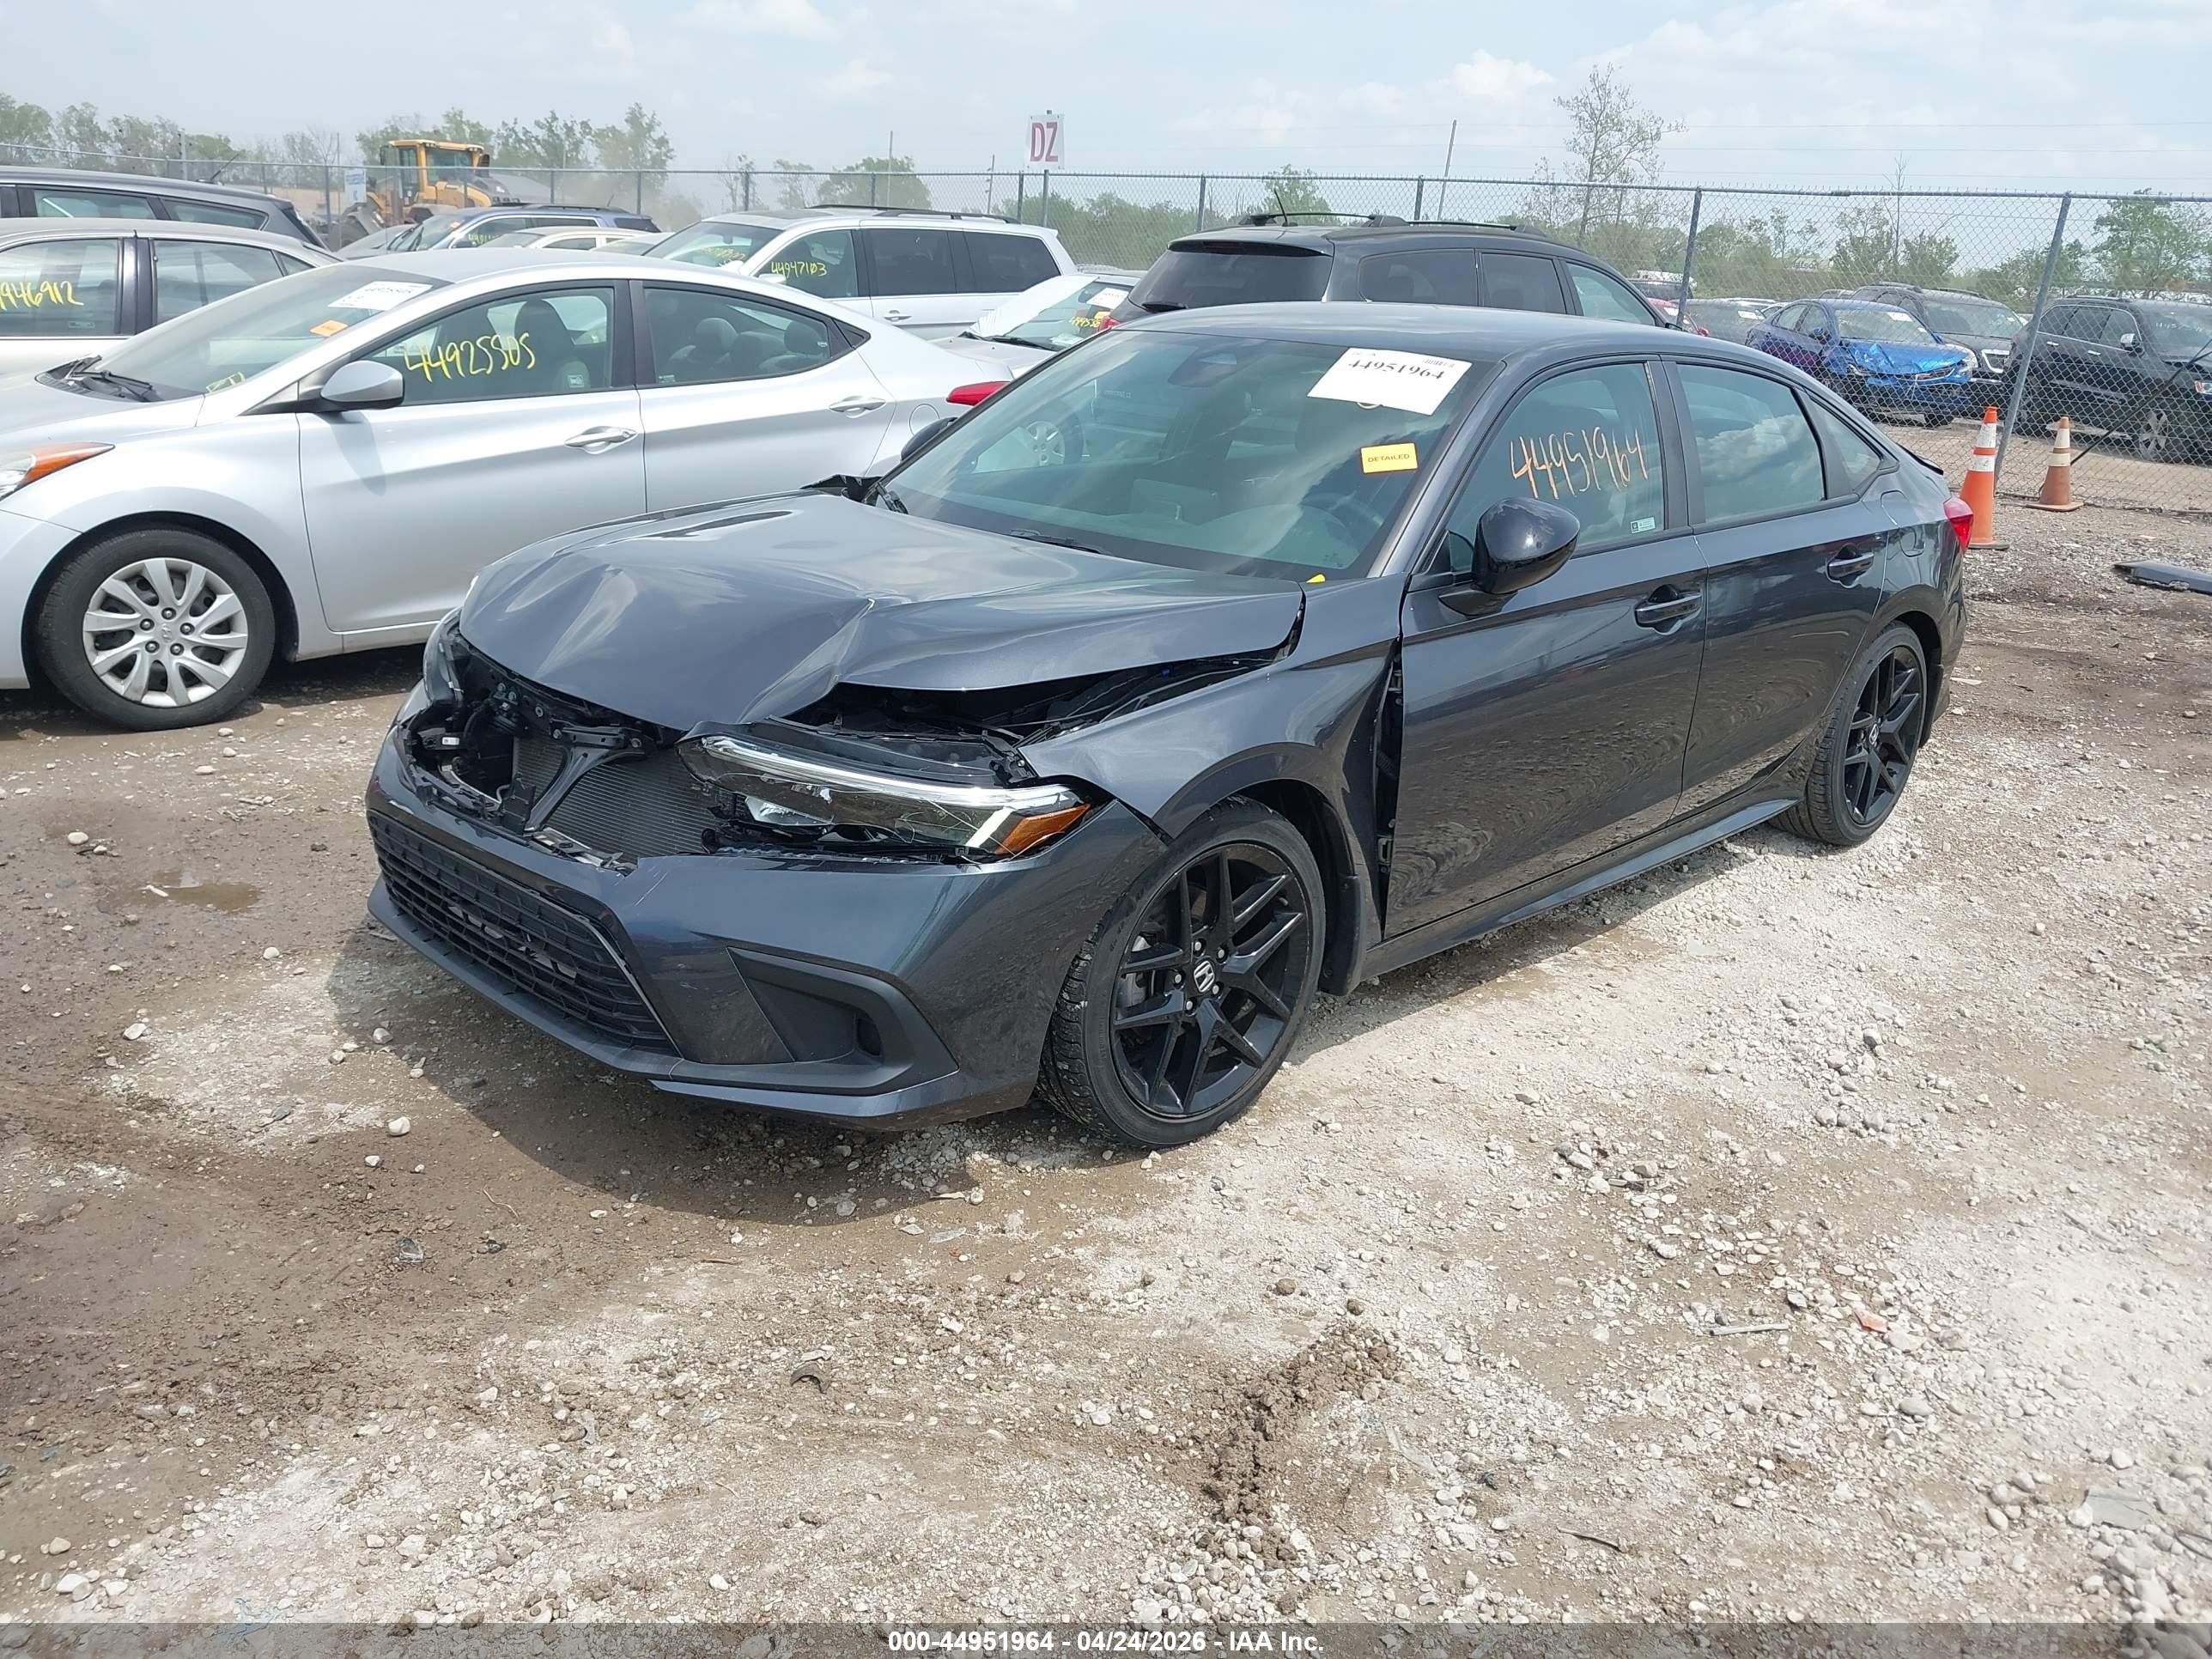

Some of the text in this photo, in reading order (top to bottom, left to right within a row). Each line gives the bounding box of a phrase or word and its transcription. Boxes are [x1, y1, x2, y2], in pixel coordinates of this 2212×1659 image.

[1030, 122, 1058, 161] DZ
[404, 332, 536, 383] 44925505
[1348, 359, 1445, 380] 44951964
[1367, 453, 1410, 463] DETAILED
[1510, 427, 1649, 500] 44951964
